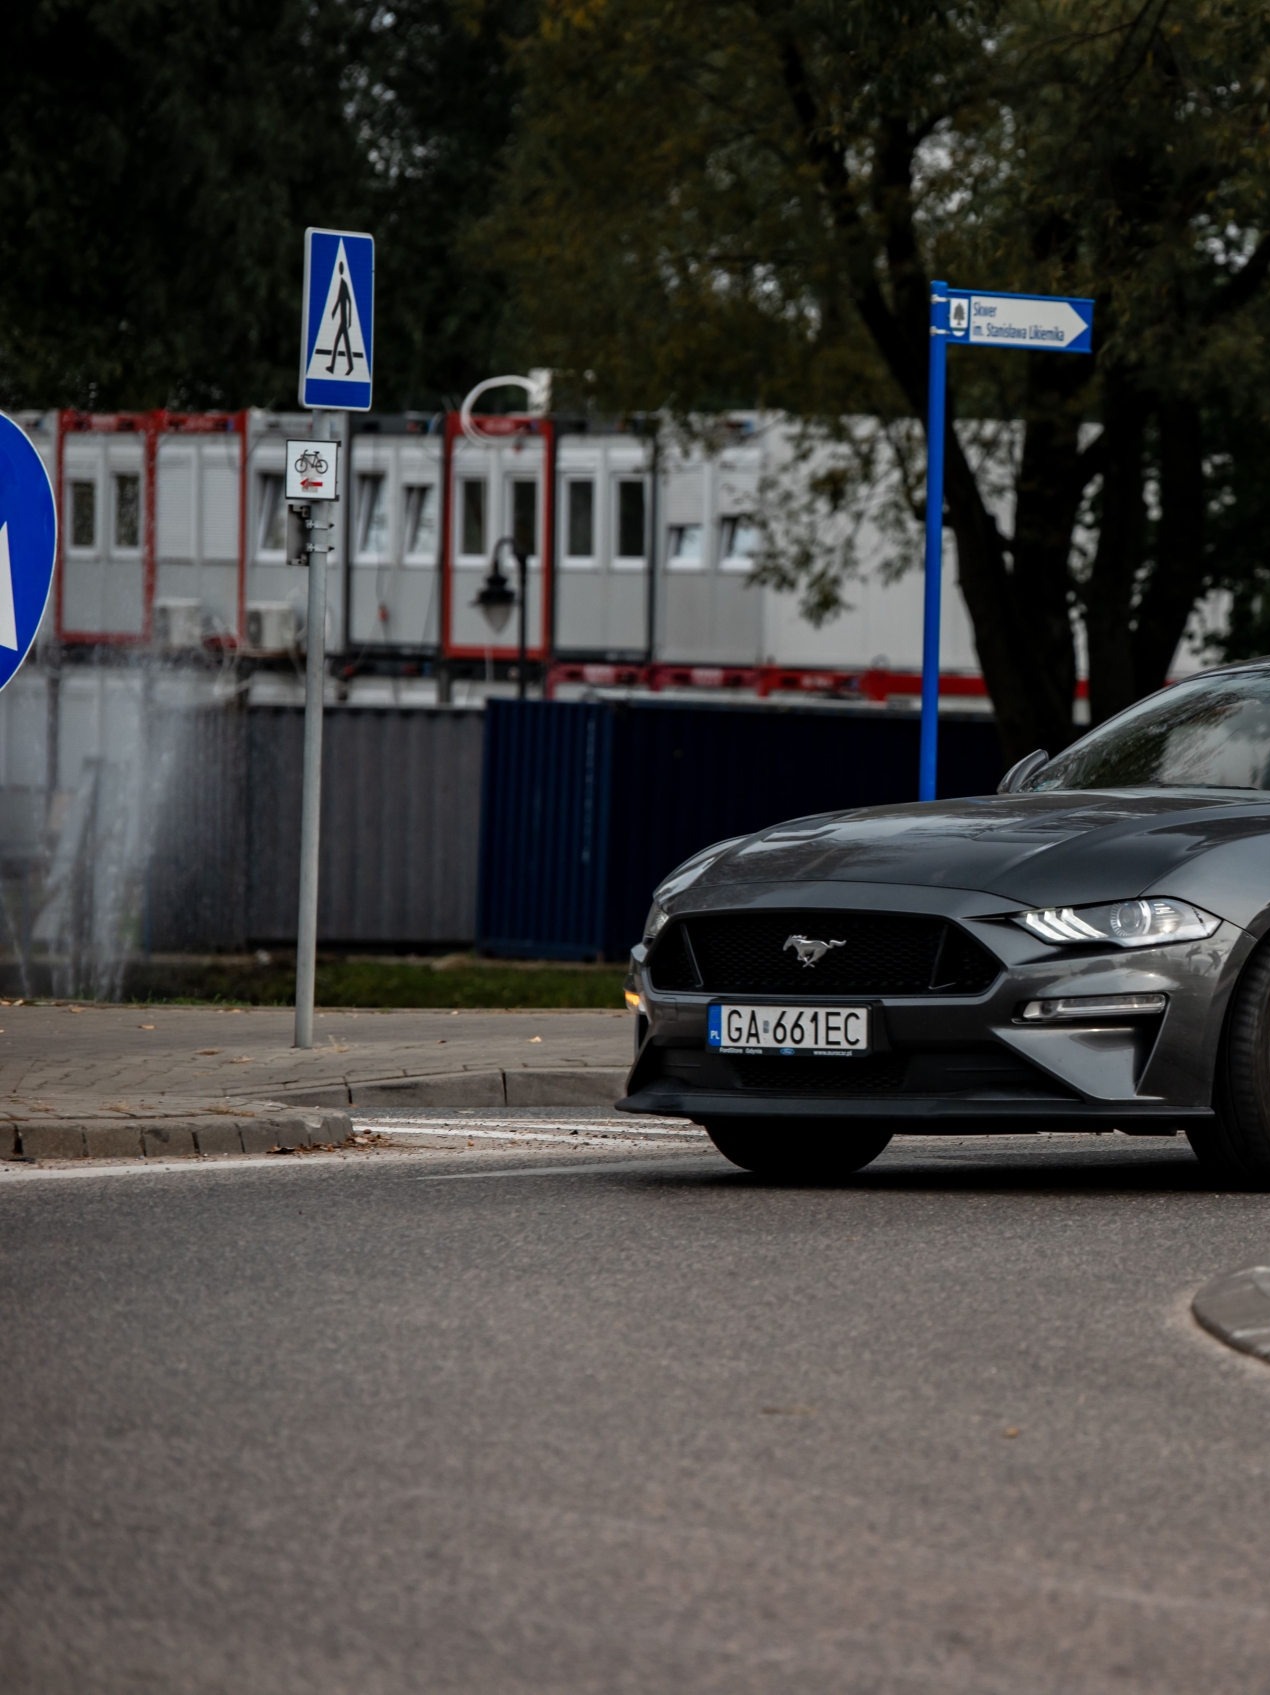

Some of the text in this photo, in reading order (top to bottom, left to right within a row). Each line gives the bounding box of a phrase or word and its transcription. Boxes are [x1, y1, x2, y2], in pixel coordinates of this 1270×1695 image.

[973, 301, 997, 317] Skwer
[972, 321, 984, 336] im.
[710, 1030, 721, 1040] PL
